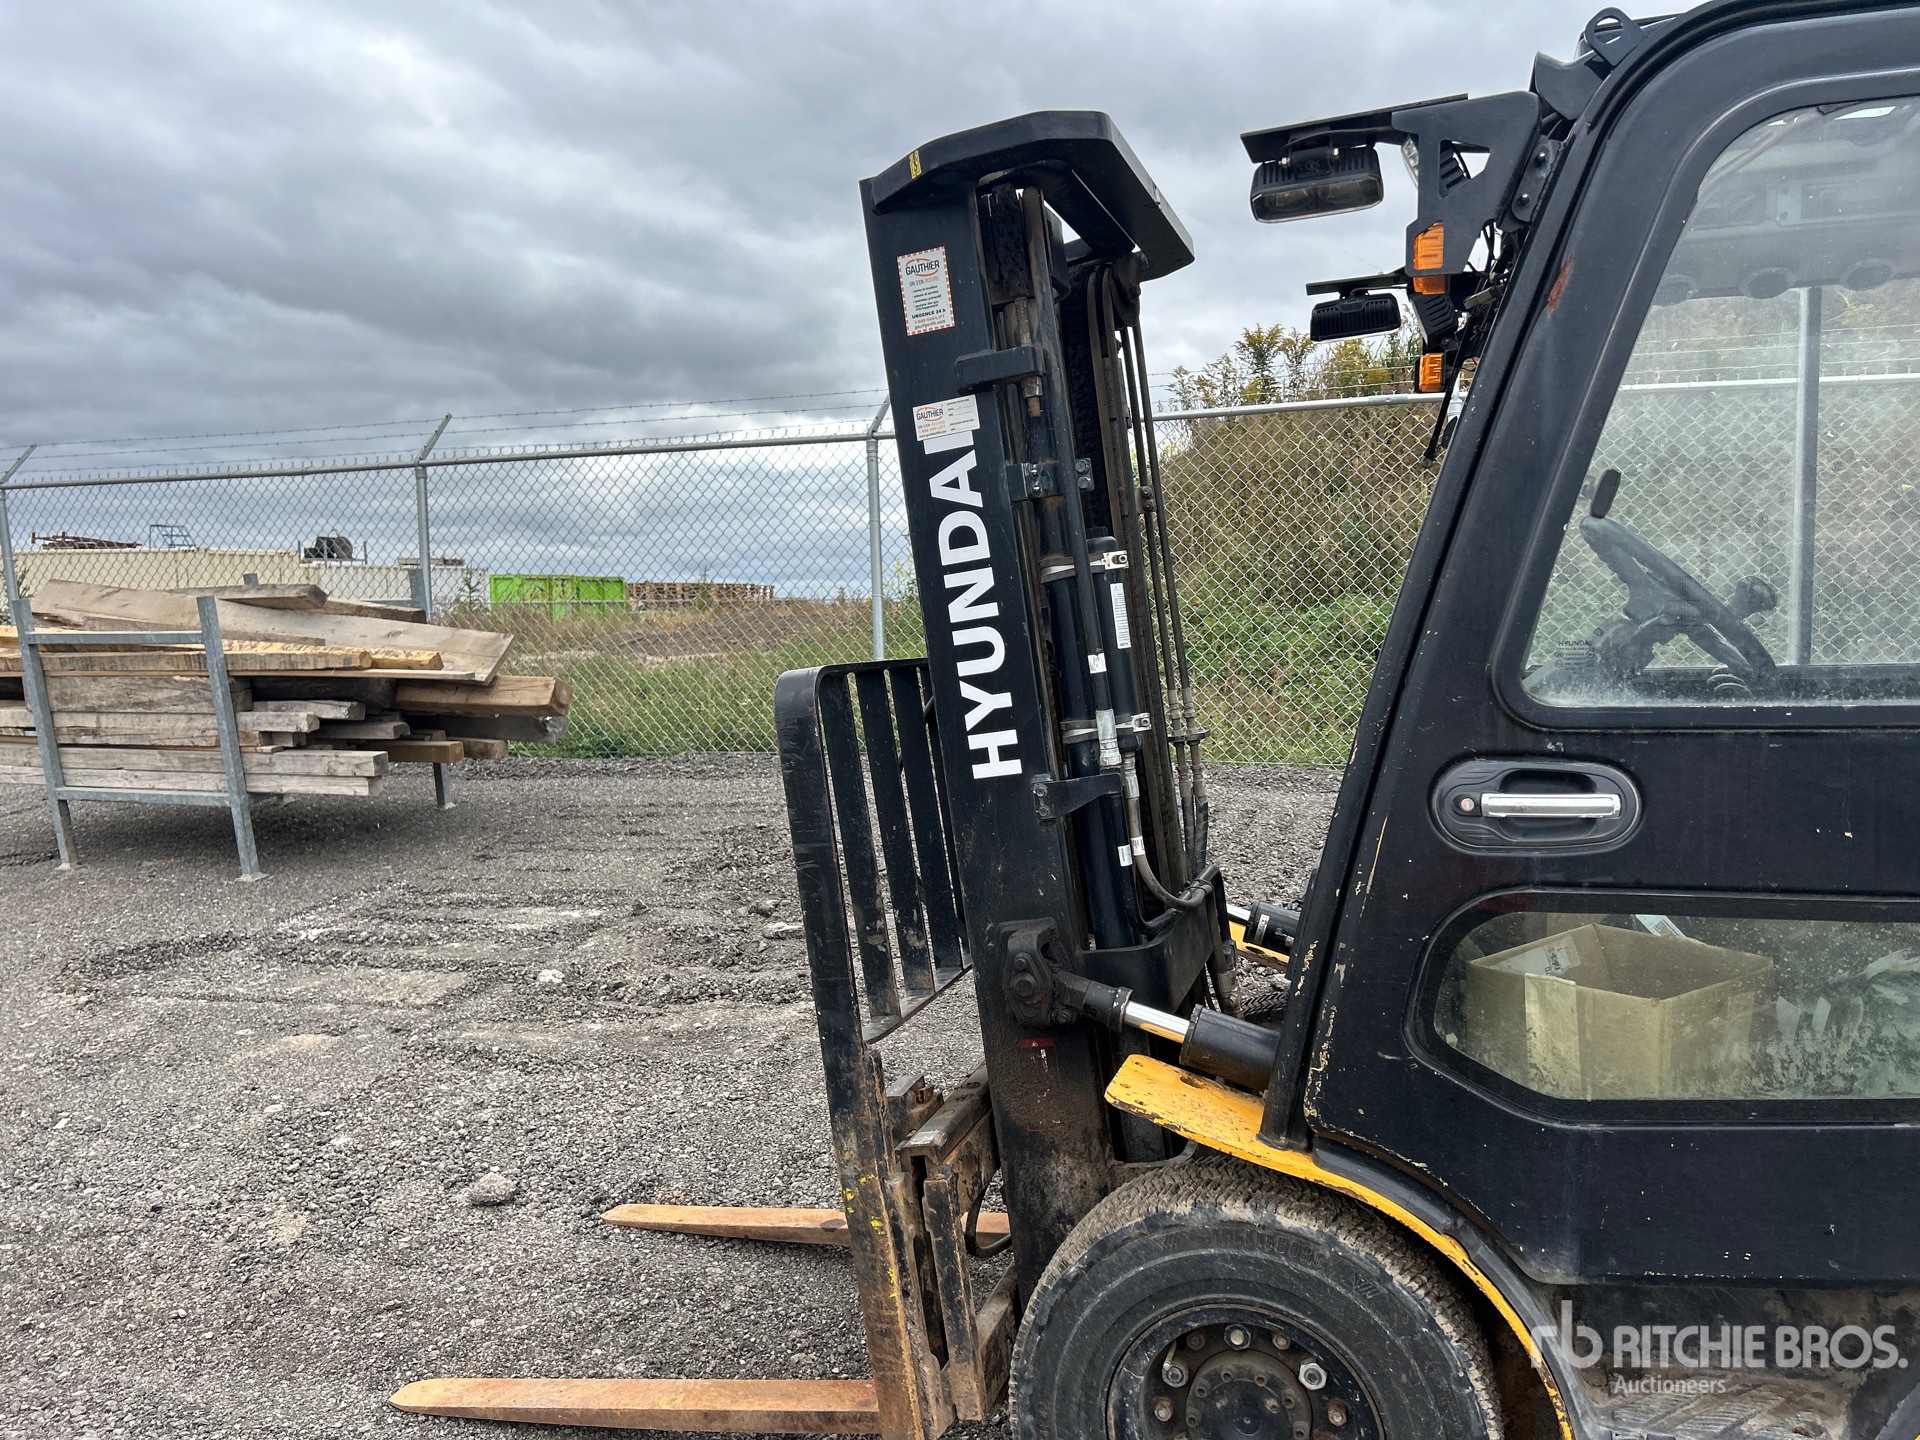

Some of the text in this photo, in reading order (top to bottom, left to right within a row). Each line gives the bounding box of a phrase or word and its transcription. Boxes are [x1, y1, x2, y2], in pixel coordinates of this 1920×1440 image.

[905, 260, 940, 276] GAUTHIER
[911, 310, 935, 319] URGENCE
[916, 408, 943, 420] GAUTHIER
[923, 430, 1023, 779] HYUNDAI
